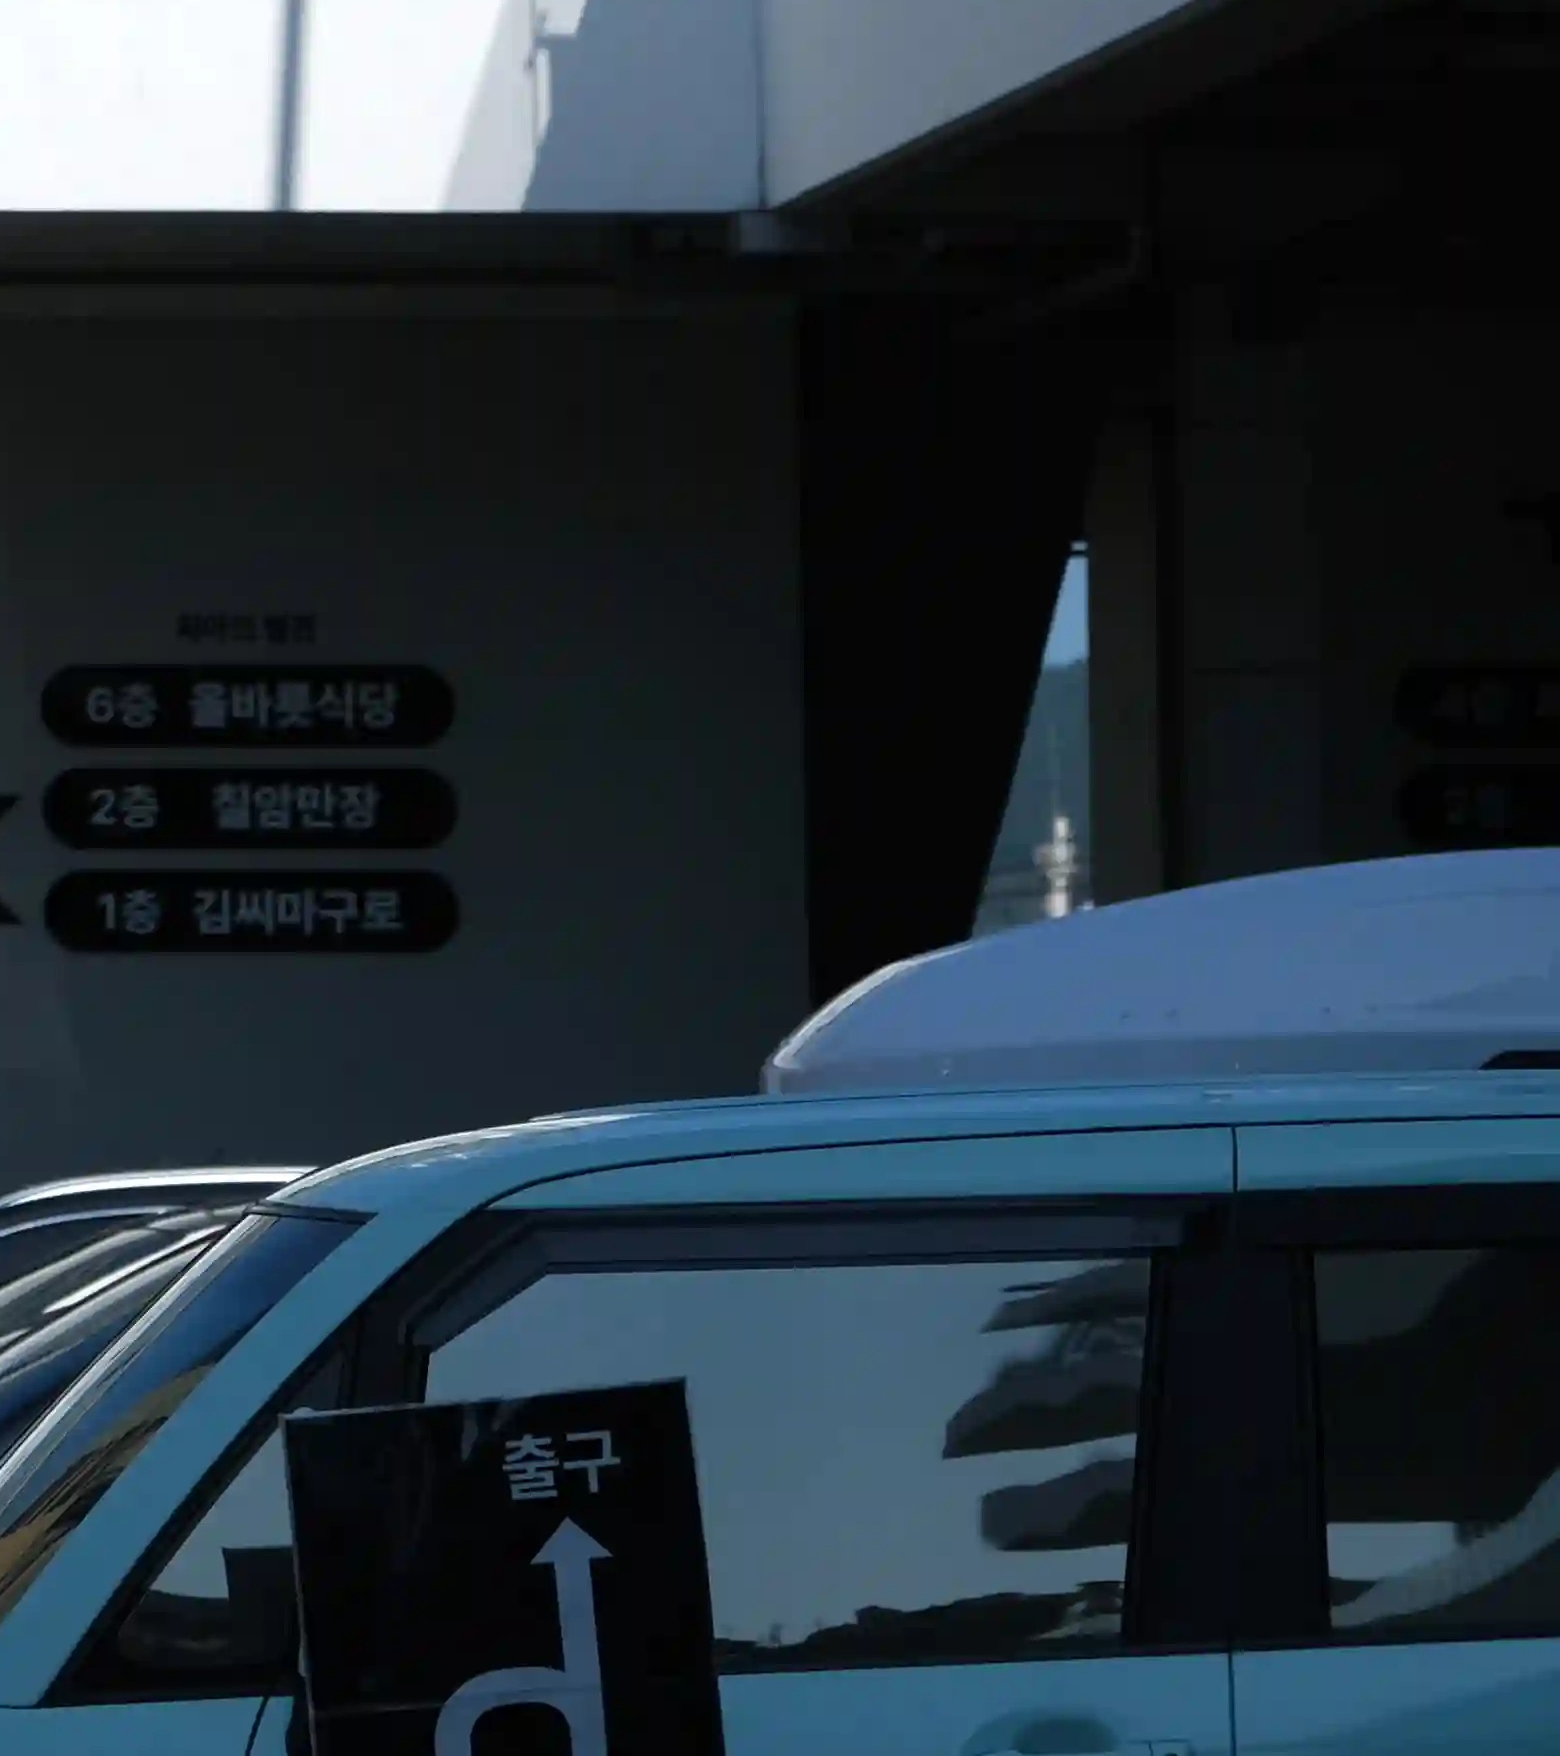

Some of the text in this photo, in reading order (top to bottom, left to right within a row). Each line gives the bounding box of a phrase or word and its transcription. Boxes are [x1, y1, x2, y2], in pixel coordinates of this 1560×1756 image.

[85, 682, 158, 728] 6층
[90, 782, 379, 829] 2층 칠암만장
[98, 889, 402, 935] 1층 김씨마구로
[502, 1429, 622, 1500] 출구
